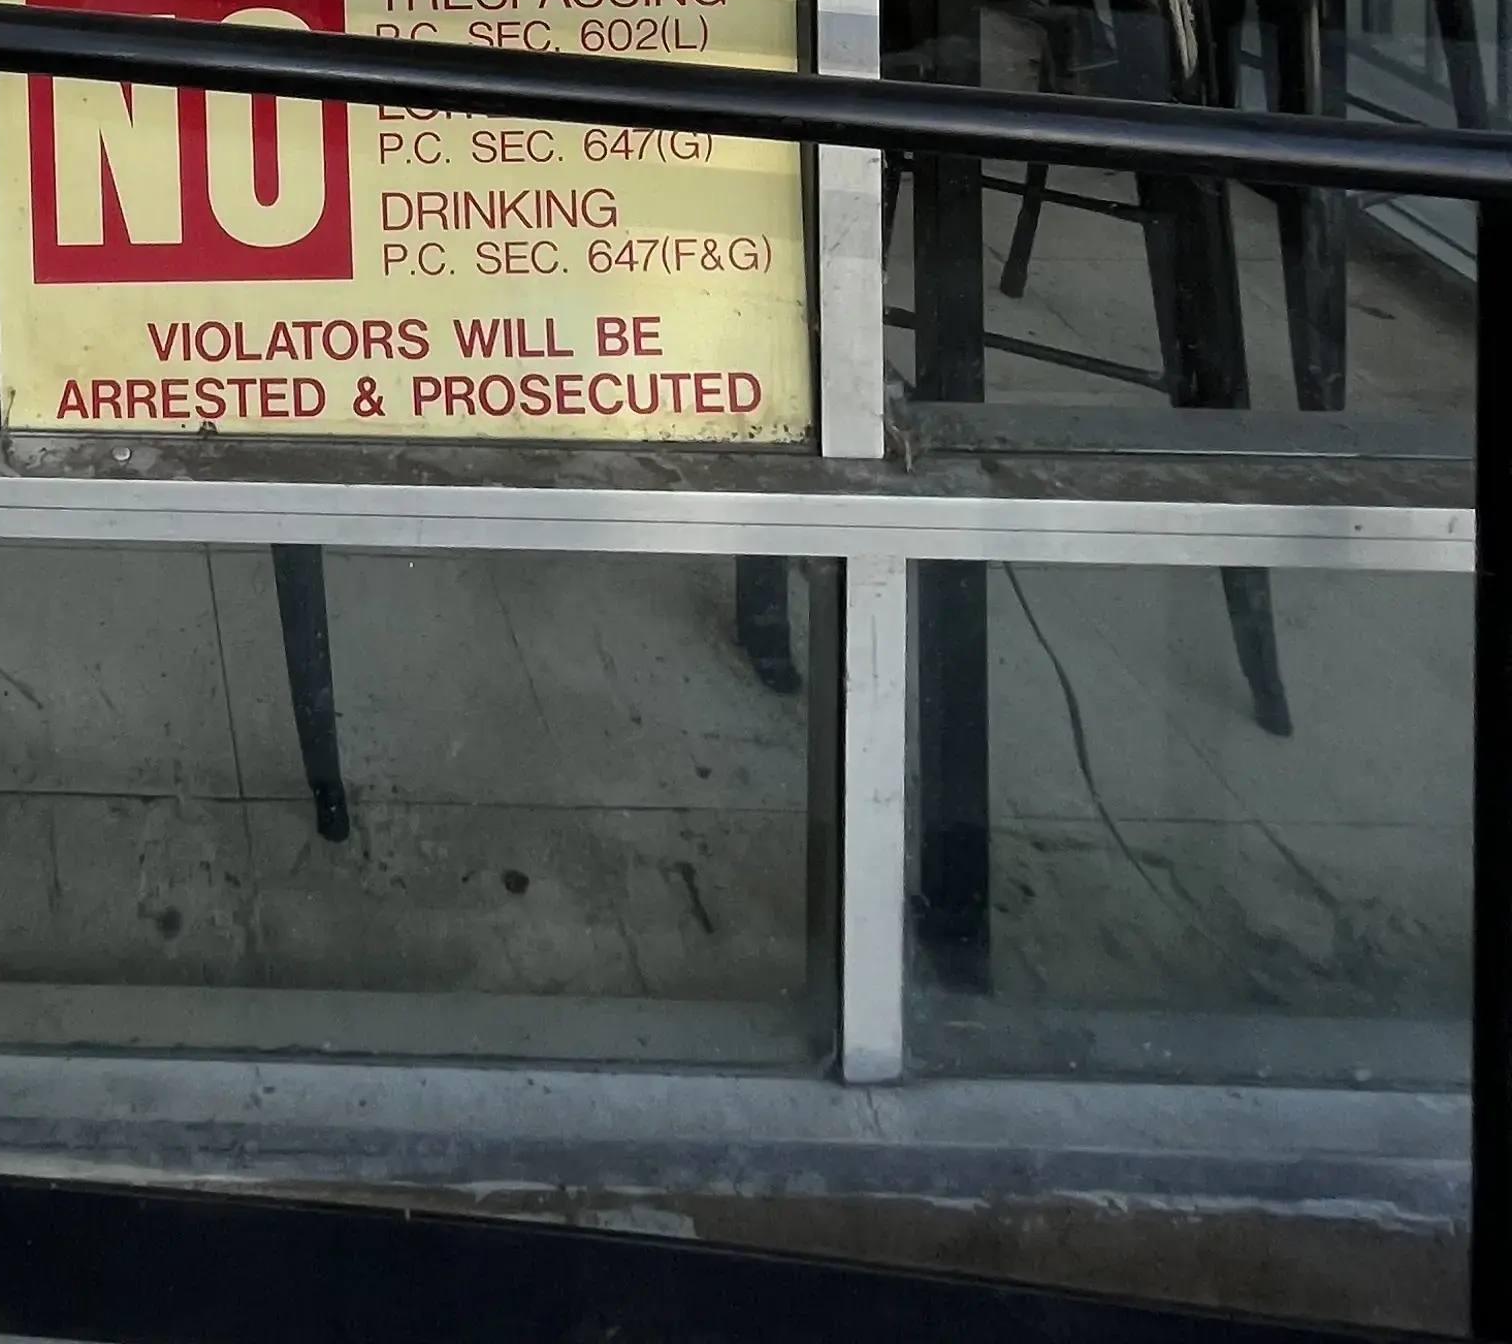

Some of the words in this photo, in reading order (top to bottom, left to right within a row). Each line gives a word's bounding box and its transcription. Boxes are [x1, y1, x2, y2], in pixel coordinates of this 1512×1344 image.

[580, 14, 709, 55] 602(L)
[51, 6, 327, 250] NO
[379, 131, 451, 166] P.C.
[472, 128, 564, 163] SEC.
[583, 127, 714, 165] 647(G)
[381, 187, 619, 232] DRINKING
[383, 242, 455, 277] P.C.
[476, 239, 568, 275] SEC.
[587, 233, 773, 276] 647(F&G)
[148, 318, 431, 365] VIOLATORS
[454, 316, 574, 360] WILL
[597, 315, 663, 357] BE
[56, 376, 327, 422] ARRESTED
[353, 375, 386, 420] &
[413, 370, 763, 420] PROSECUTED
